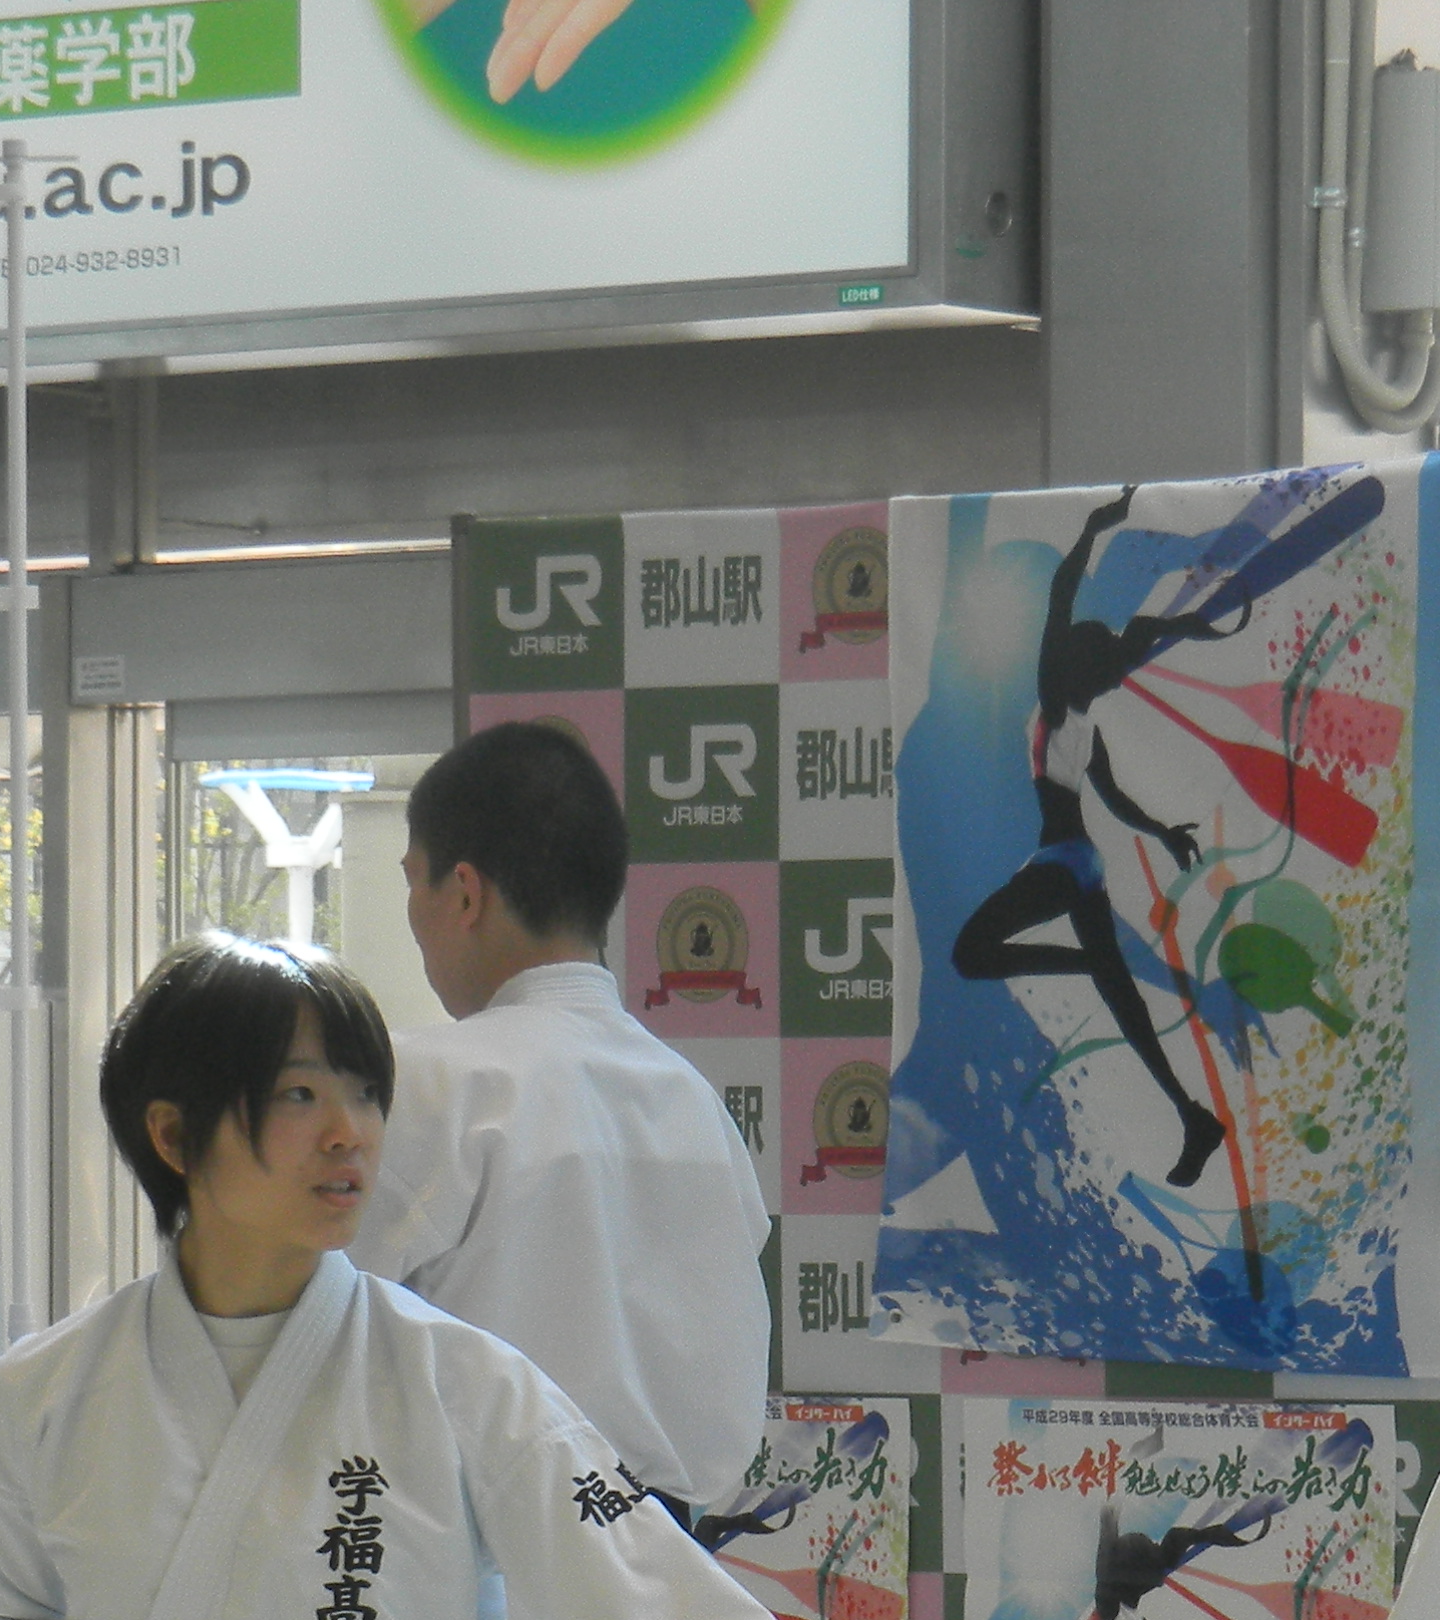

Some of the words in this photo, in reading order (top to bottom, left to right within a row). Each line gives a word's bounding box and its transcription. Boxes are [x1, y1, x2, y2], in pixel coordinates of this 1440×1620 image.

[26, 245, 181, 277] 024-932-8931
[496, 553, 603, 632] JR
[640, 555, 763, 630] 郡山駅
[509, 633, 590, 657] JR東日本
[648, 722, 758, 801] JR
[663, 805, 744, 827] JR東日本
[1021, 1408, 1095, 1426] 平成29年度
[1271, 1415, 1336, 1430] インターハイ
